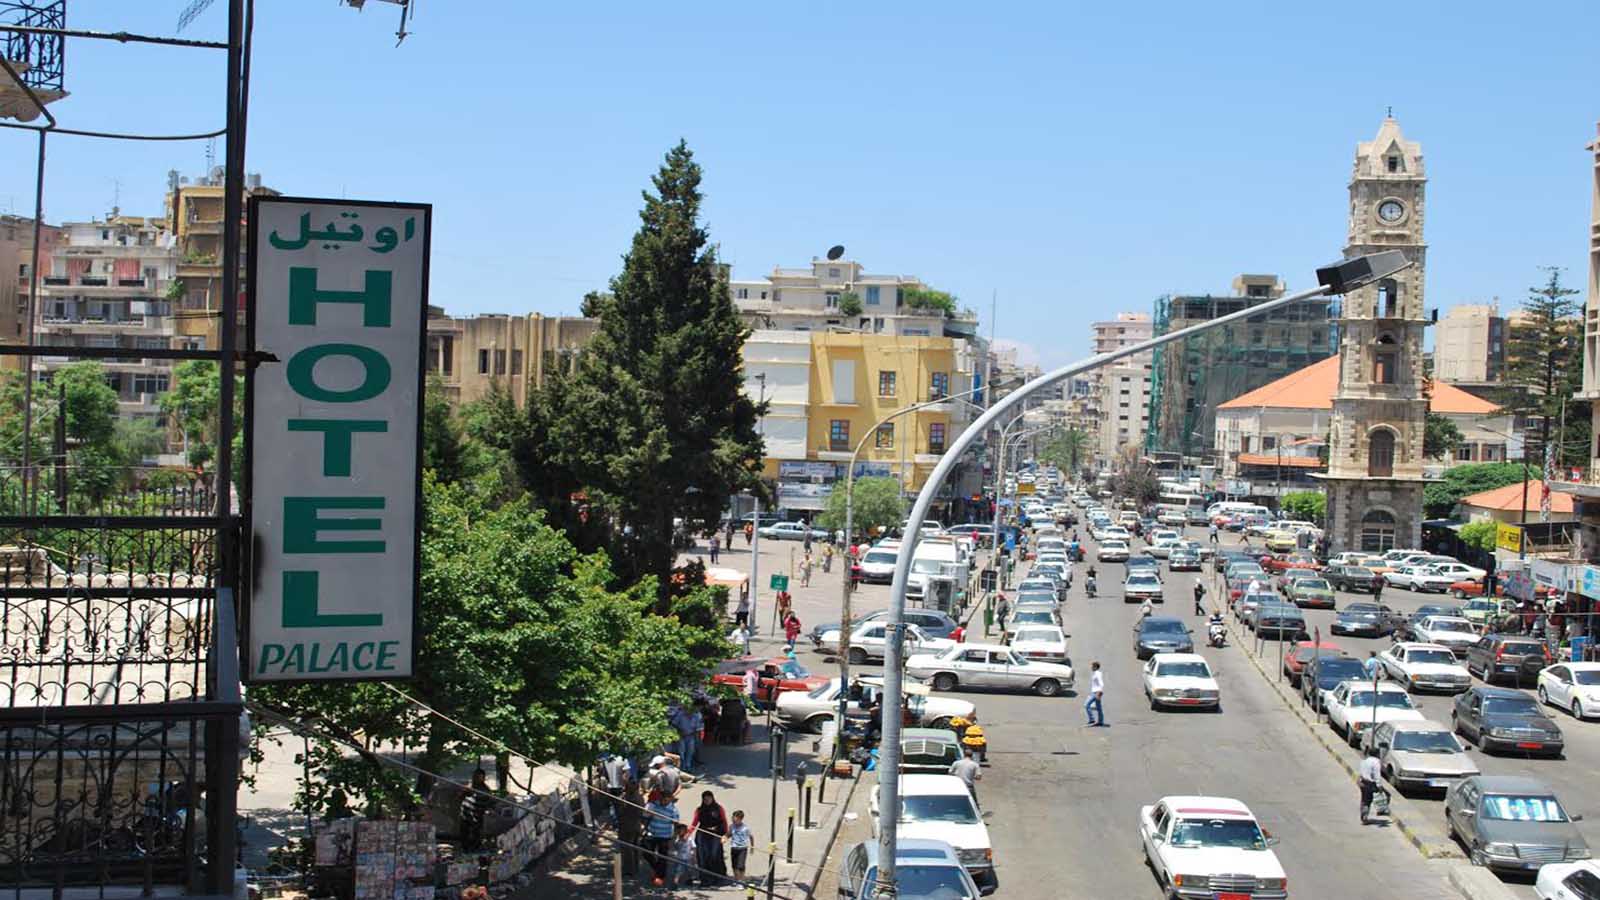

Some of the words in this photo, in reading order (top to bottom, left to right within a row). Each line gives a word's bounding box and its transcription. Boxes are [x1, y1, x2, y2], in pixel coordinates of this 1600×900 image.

[269, 211, 415, 252] اوتيل
[282, 267, 392, 628] HOTEL
[257, 640, 400, 674] PALACE
